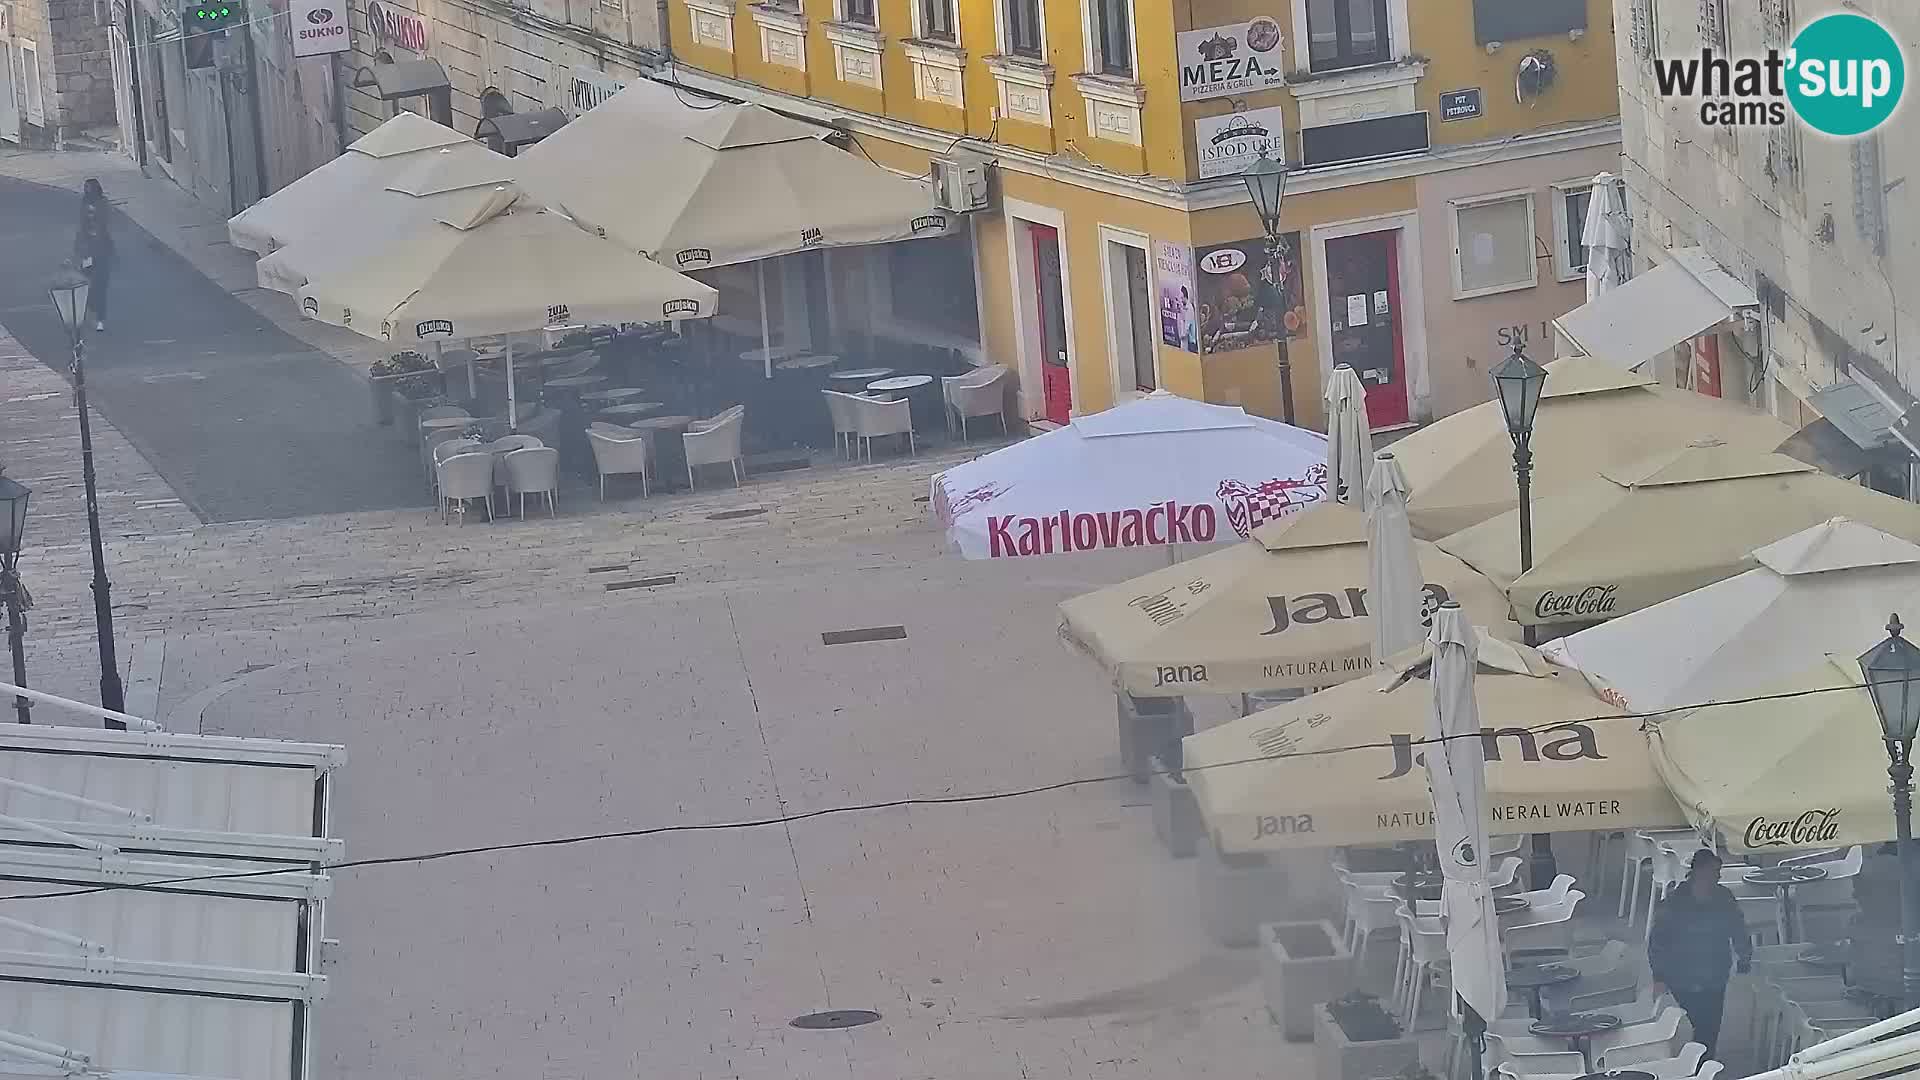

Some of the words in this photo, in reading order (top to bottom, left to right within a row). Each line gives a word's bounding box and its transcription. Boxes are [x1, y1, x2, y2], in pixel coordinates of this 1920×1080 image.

[299, 25, 344, 40] SUKNO
[385, 9, 425, 51] SUKNO
[1183, 56, 1262, 87] MEZA
[1192, 82, 1226, 95] PIZZERIA
[1226, 80, 1232, 89] &
[1233, 78, 1254, 90] GRILL
[1201, 141, 1248, 161] ISPOD
[801, 227, 821, 241] ŽUJA
[547, 304, 569, 318] ŽUJA
[986, 500, 1217, 558] Karlovačko
[1154, 663, 1209, 688] jana
[1263, 660, 1339, 679] NATURAL
[1377, 724, 1609, 780] jna
[1377, 811, 1440, 829] NATUR
[1491, 803, 1552, 821] NERAL
[1556, 799, 1621, 817] WATER
[1252, 813, 1316, 841] jana
